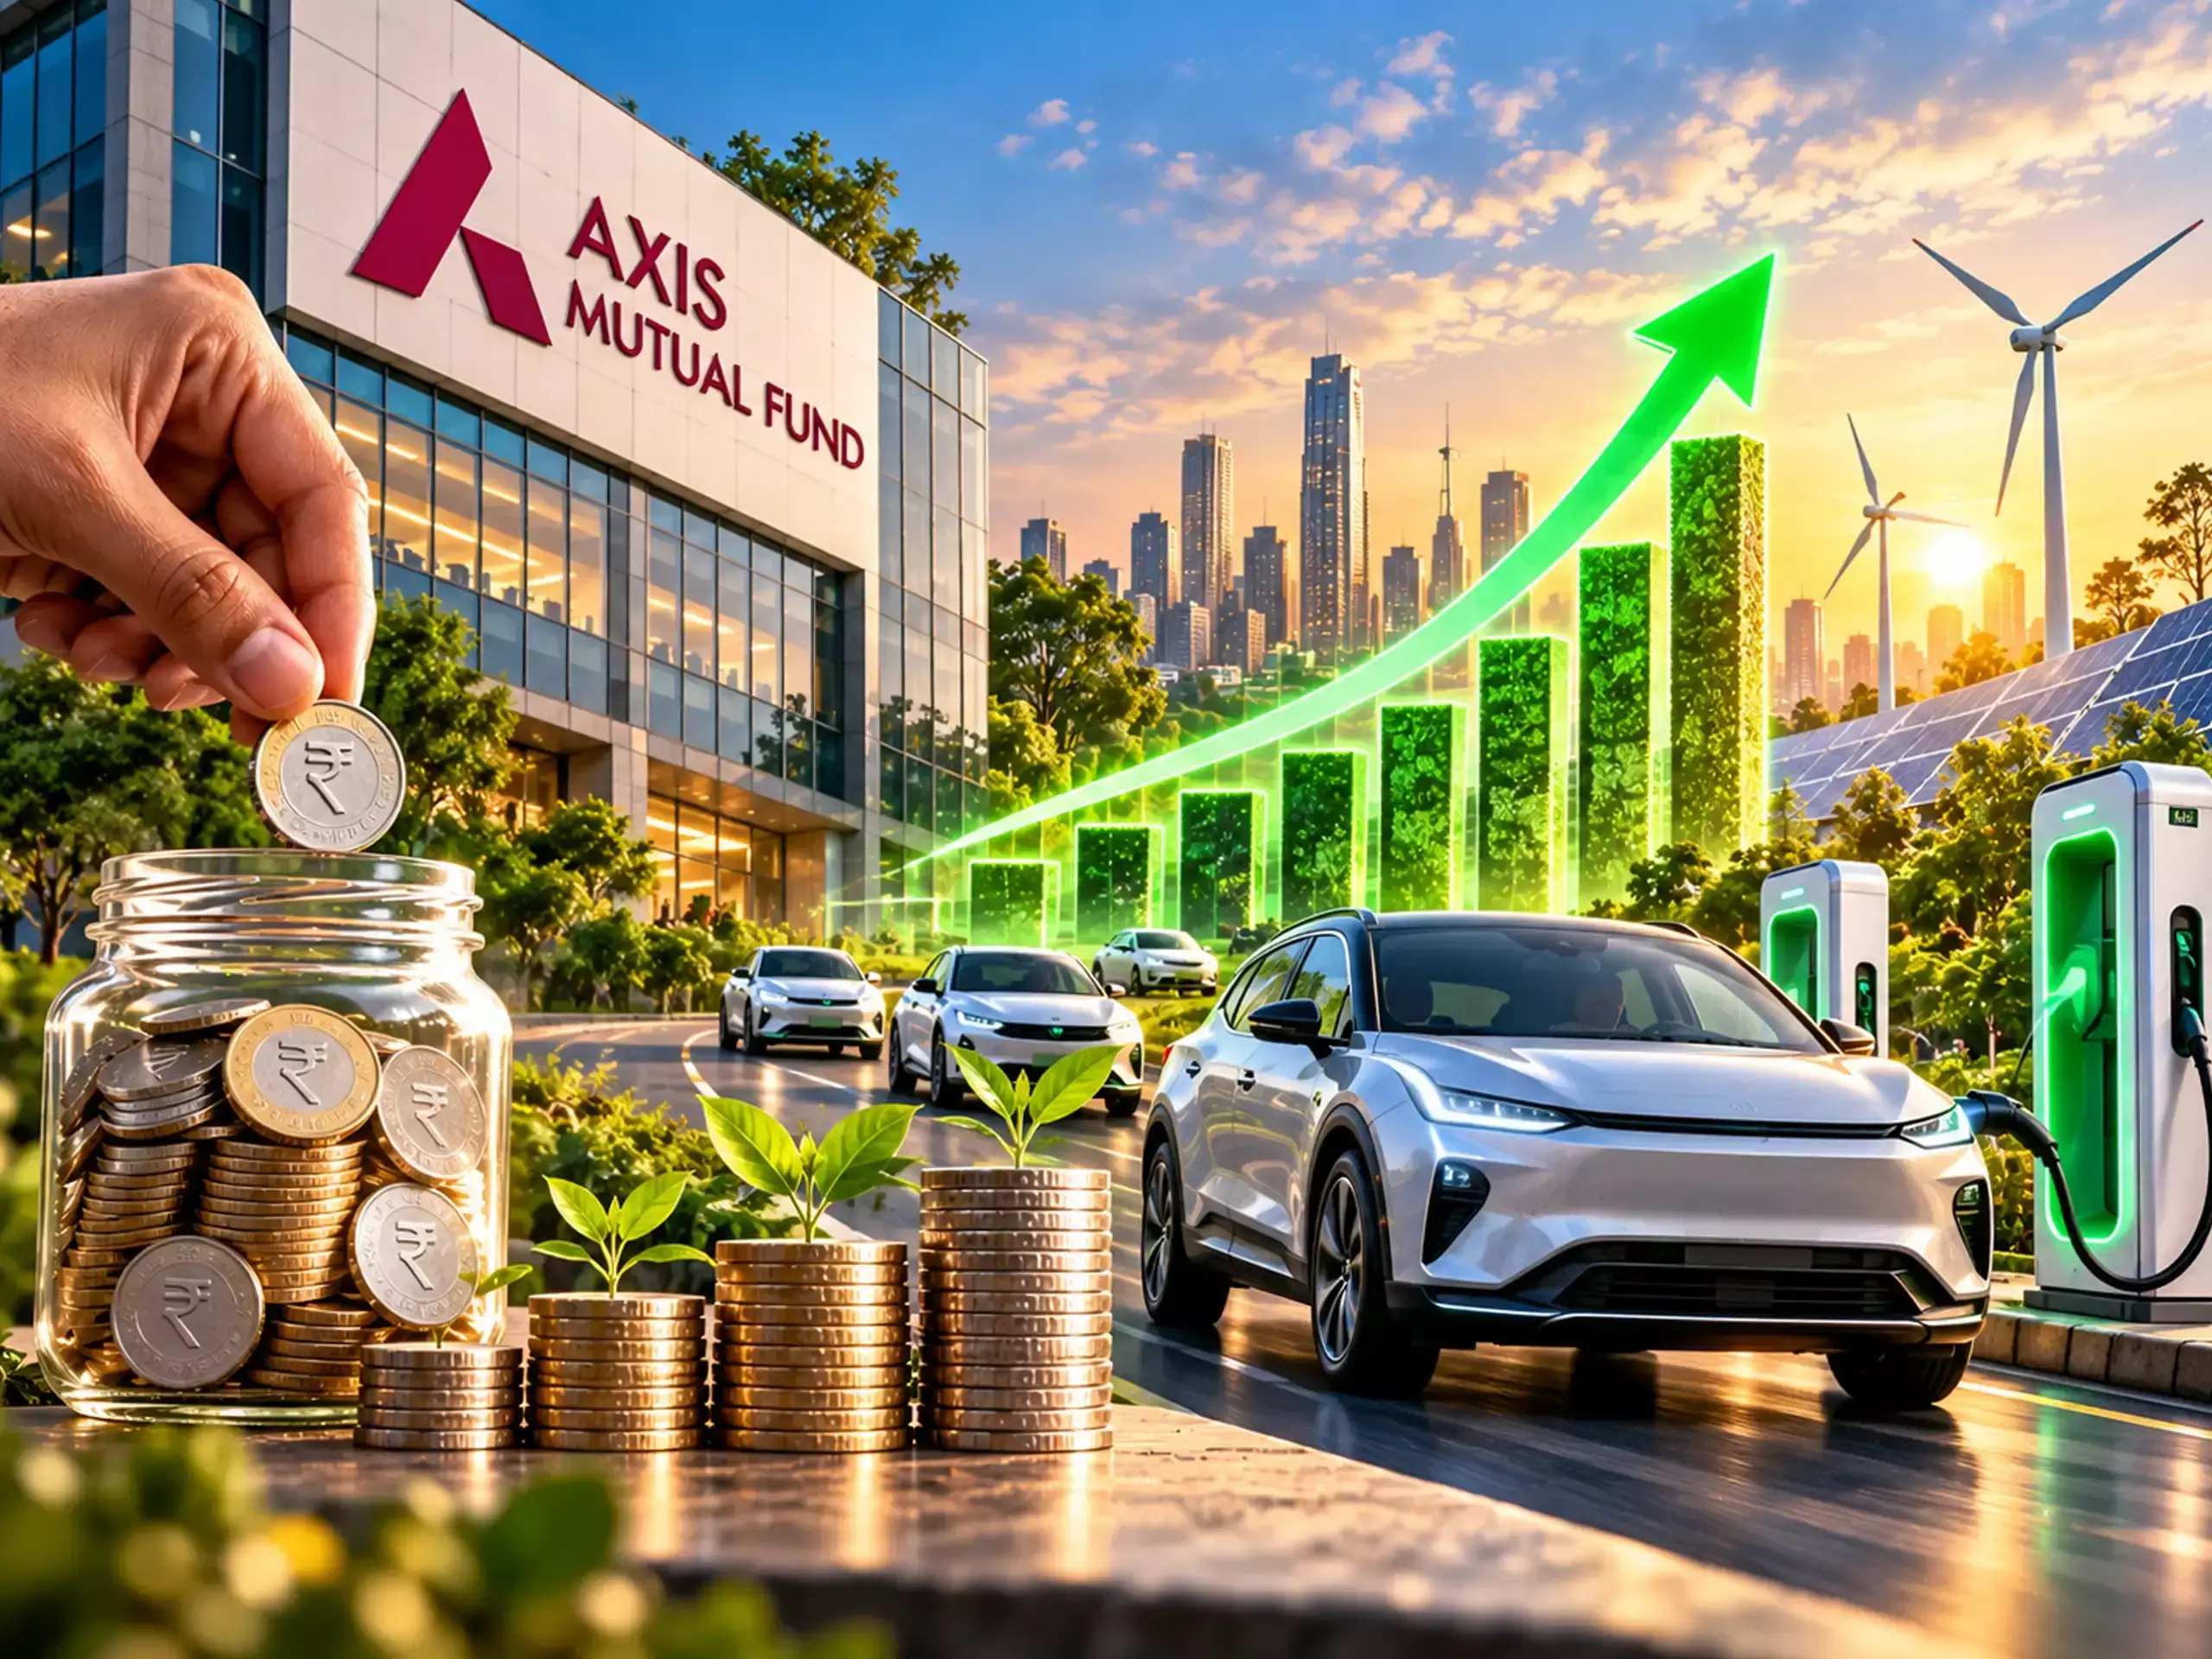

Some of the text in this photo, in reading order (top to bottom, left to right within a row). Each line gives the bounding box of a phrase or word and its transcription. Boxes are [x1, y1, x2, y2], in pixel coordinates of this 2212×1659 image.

[567, 195, 728, 332] AXIS
[565, 278, 865, 470] MUTUAL FUND
